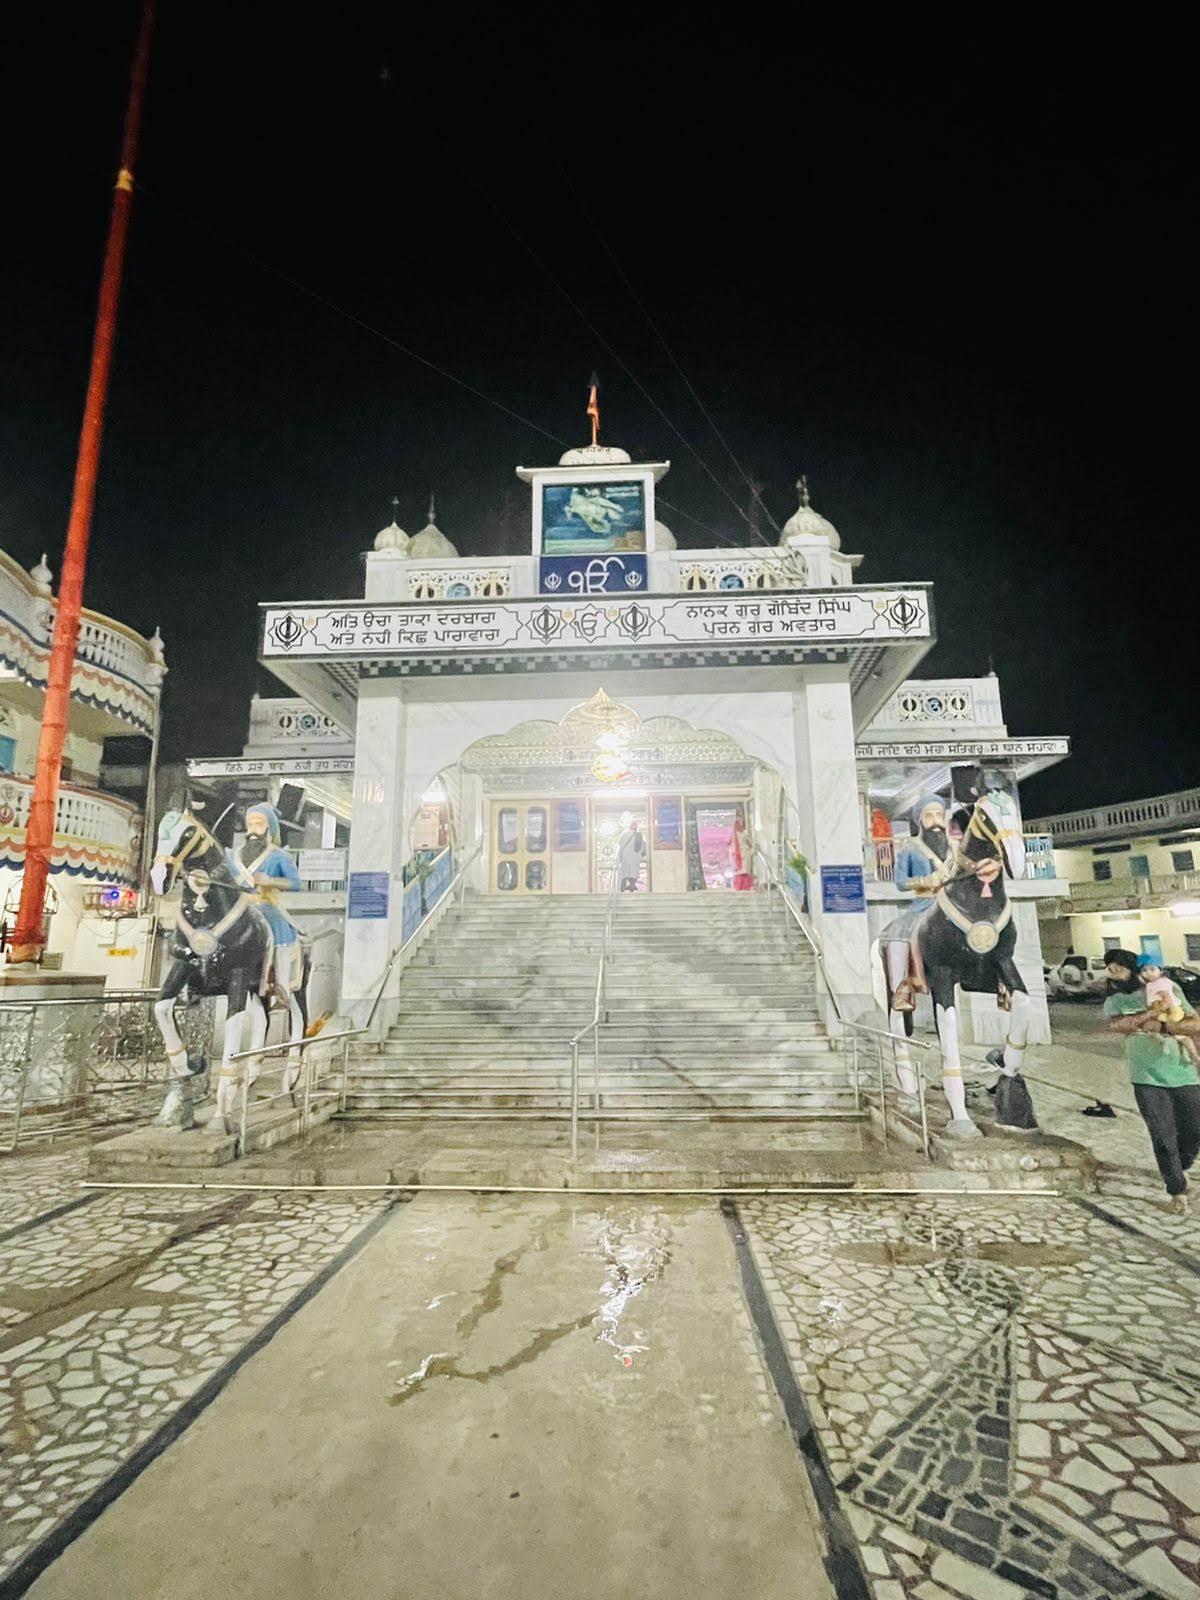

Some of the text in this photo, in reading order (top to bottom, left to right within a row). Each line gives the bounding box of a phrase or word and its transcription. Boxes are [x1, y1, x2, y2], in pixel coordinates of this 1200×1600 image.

[685, 605, 728, 618] ਨਾਨਕ
[766, 600, 811, 616] ਗੋਬਿੰਦ
[818, 598, 851, 615] ਸਿੰਘ
[331, 613, 358, 628] ਅਤਿ
[437, 612, 496, 625] ਦਰਬਾਰਾ
[780, 618, 836, 633] ਅਵਤਾਰ
[362, 629, 391, 644] ਨਹੀ
[433, 629, 500, 642] ਪਾਰਾਵਾਰਾ
